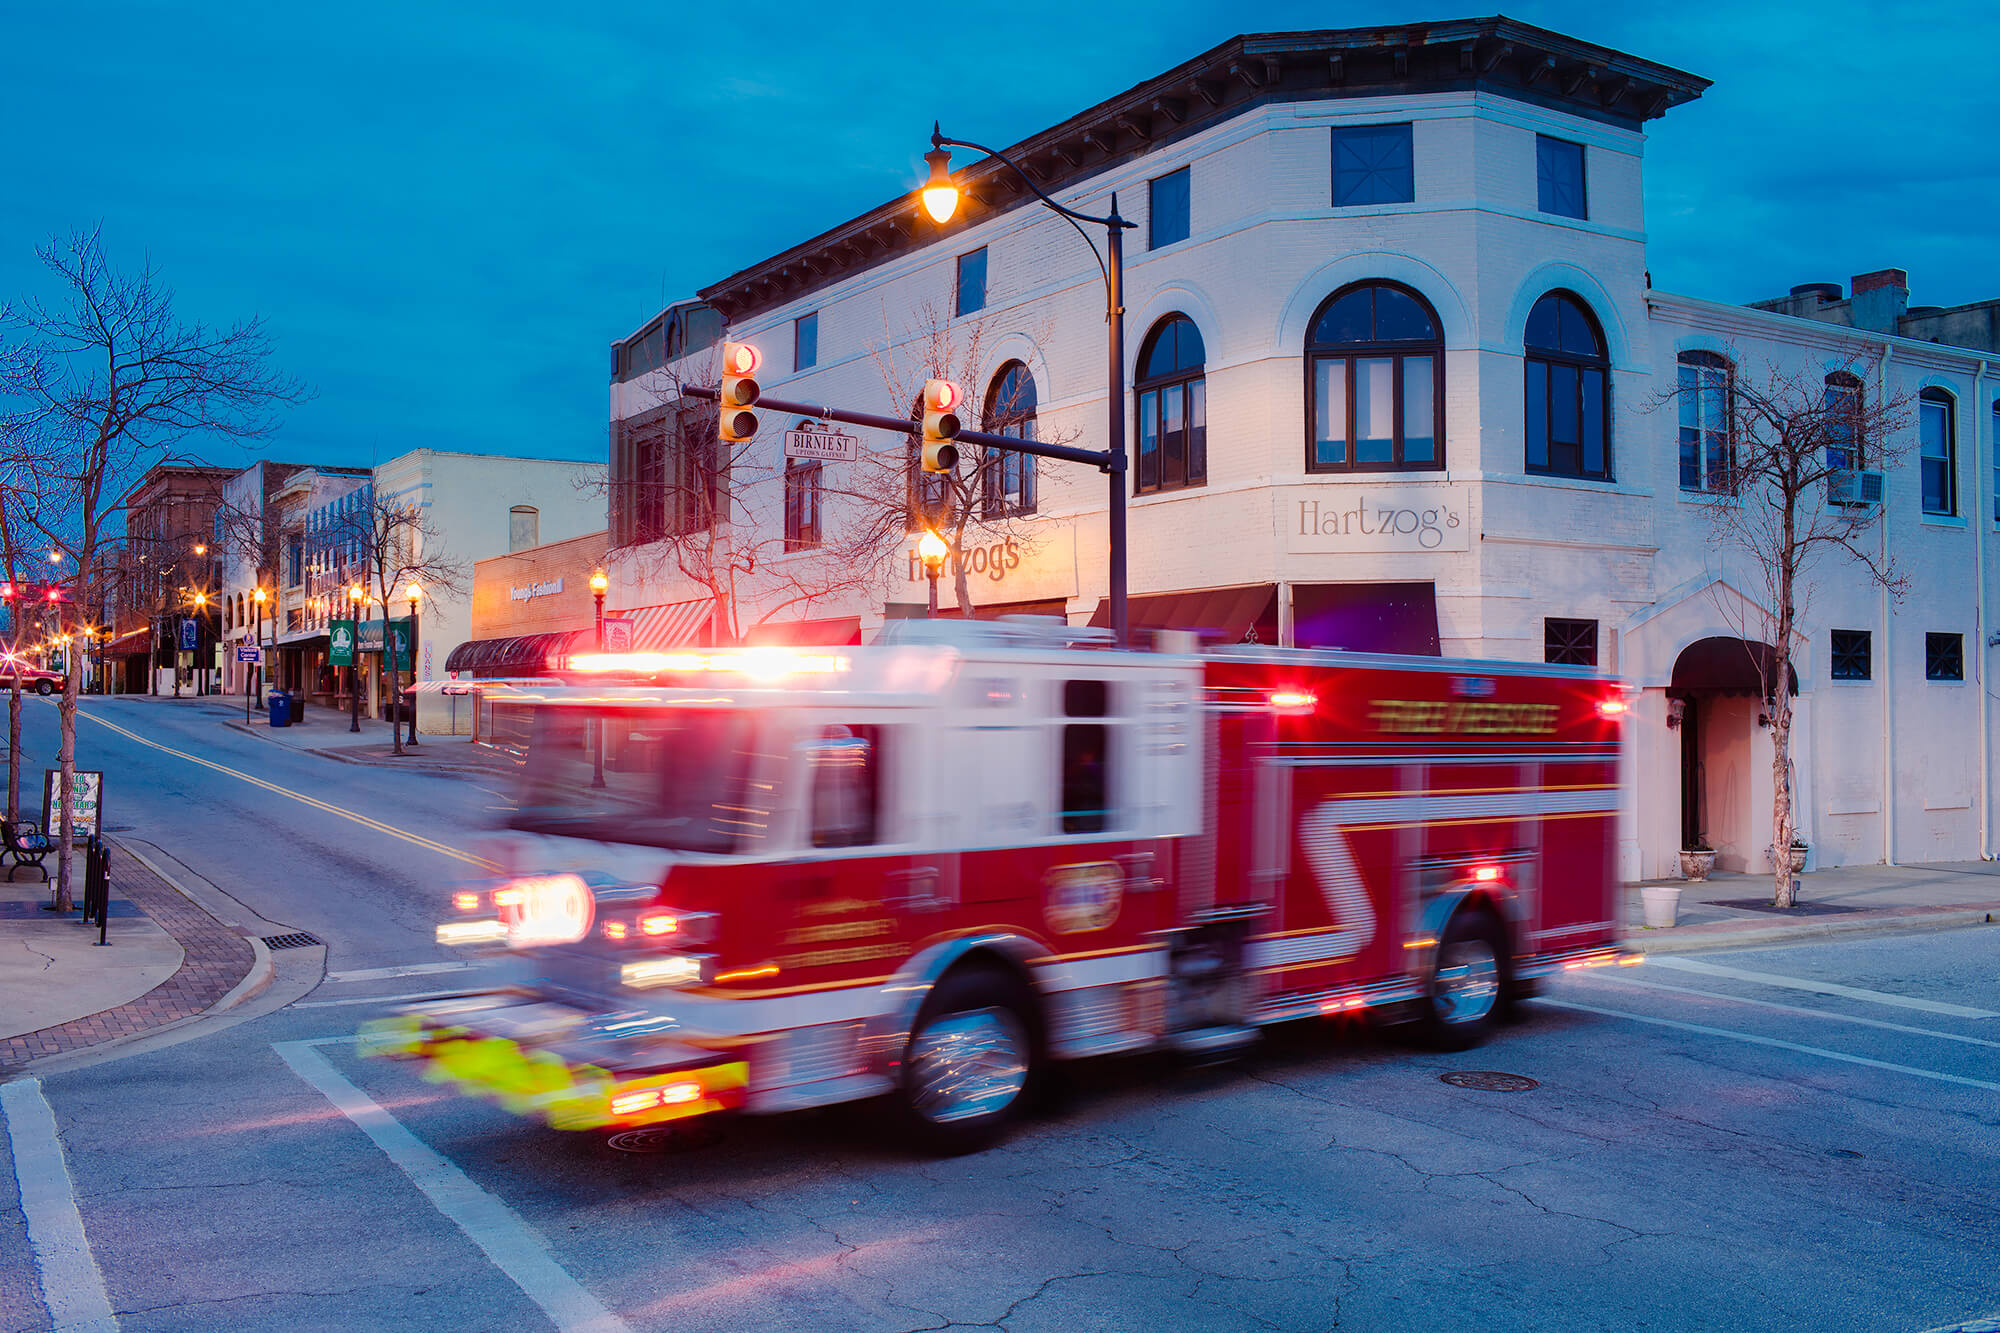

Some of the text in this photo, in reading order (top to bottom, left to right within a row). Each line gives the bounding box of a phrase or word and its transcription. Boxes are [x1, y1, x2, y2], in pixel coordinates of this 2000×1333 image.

[793, 434, 850, 452] BIRNIE ST
[1298, 495, 1461, 549] Hartzog's
[907, 536, 1020, 582] Hrtzog's
[424, 647, 432, 677] LOANS
